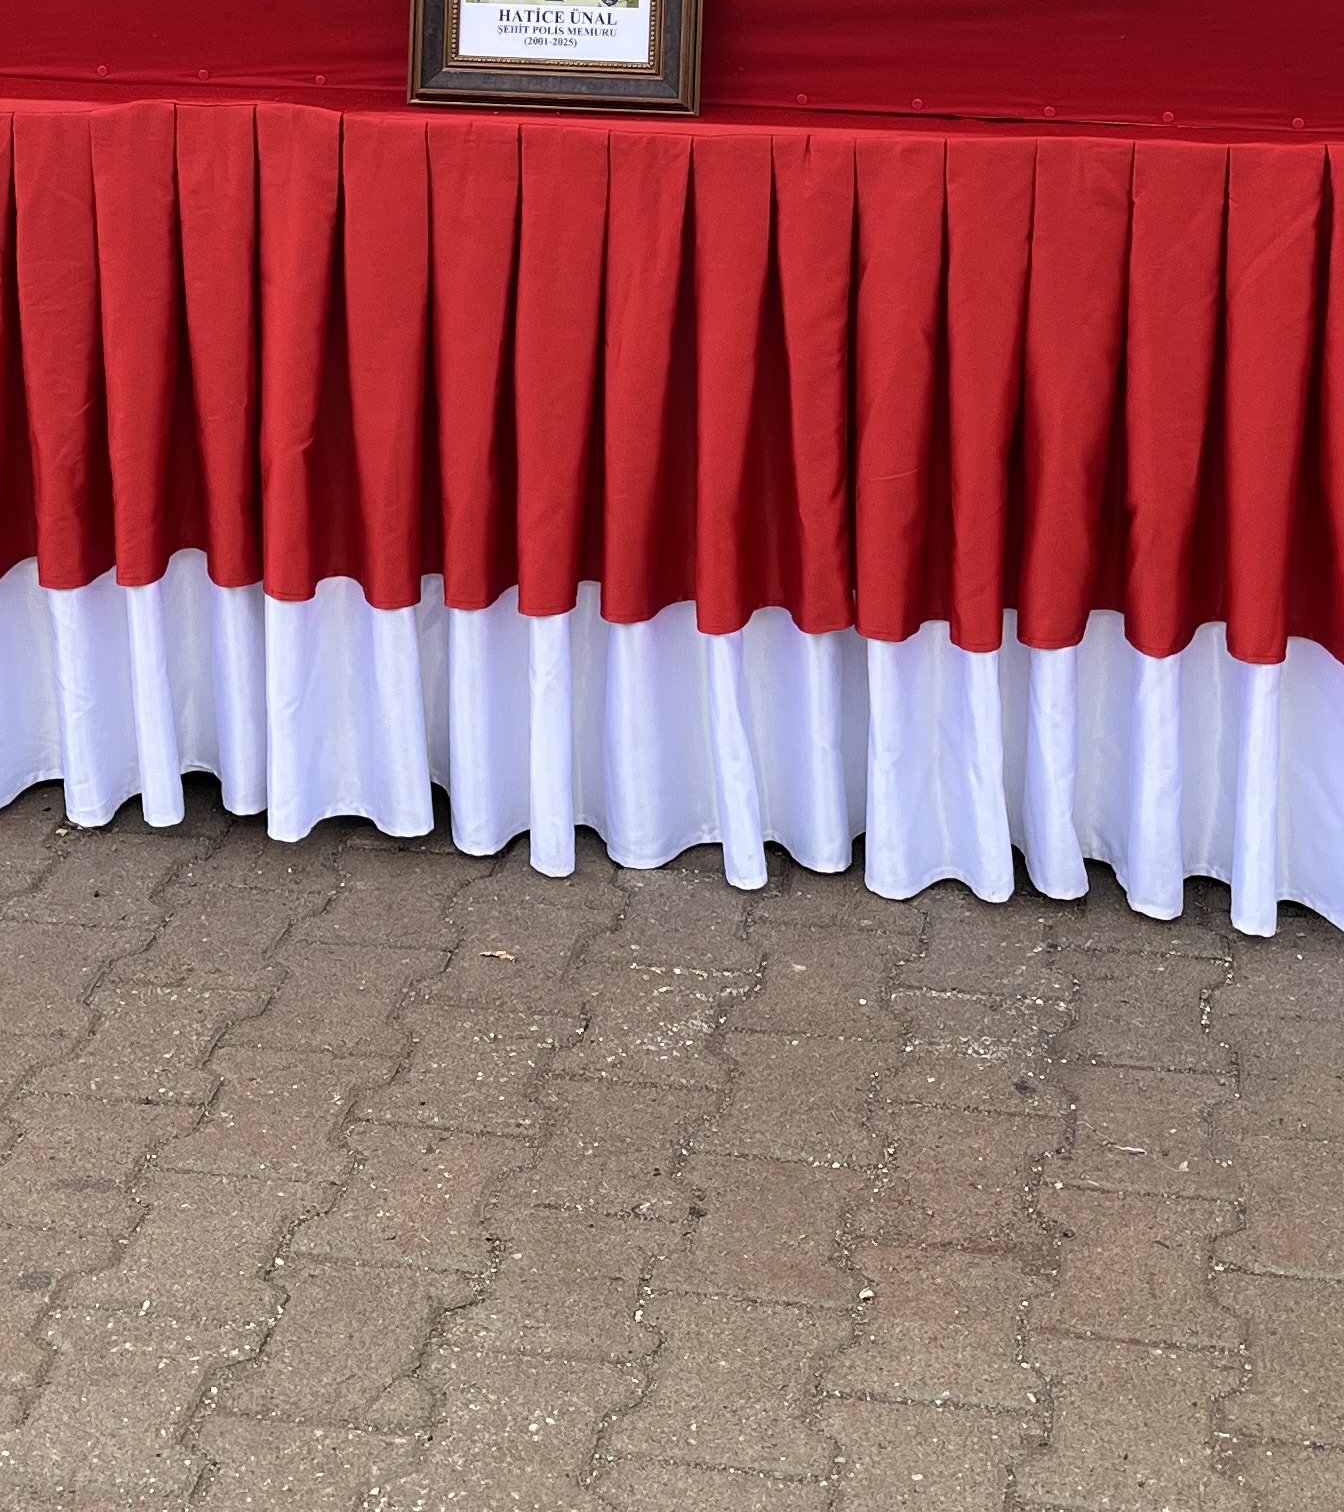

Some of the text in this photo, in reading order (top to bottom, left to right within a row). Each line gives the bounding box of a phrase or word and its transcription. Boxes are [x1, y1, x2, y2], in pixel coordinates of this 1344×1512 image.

[498, 7, 618, 25] HATİCE ÜNAL
[497, 24, 617, 37] ŞEHİT POLİS MEMURU
[524, 37, 577, 48] (2001-2025)
